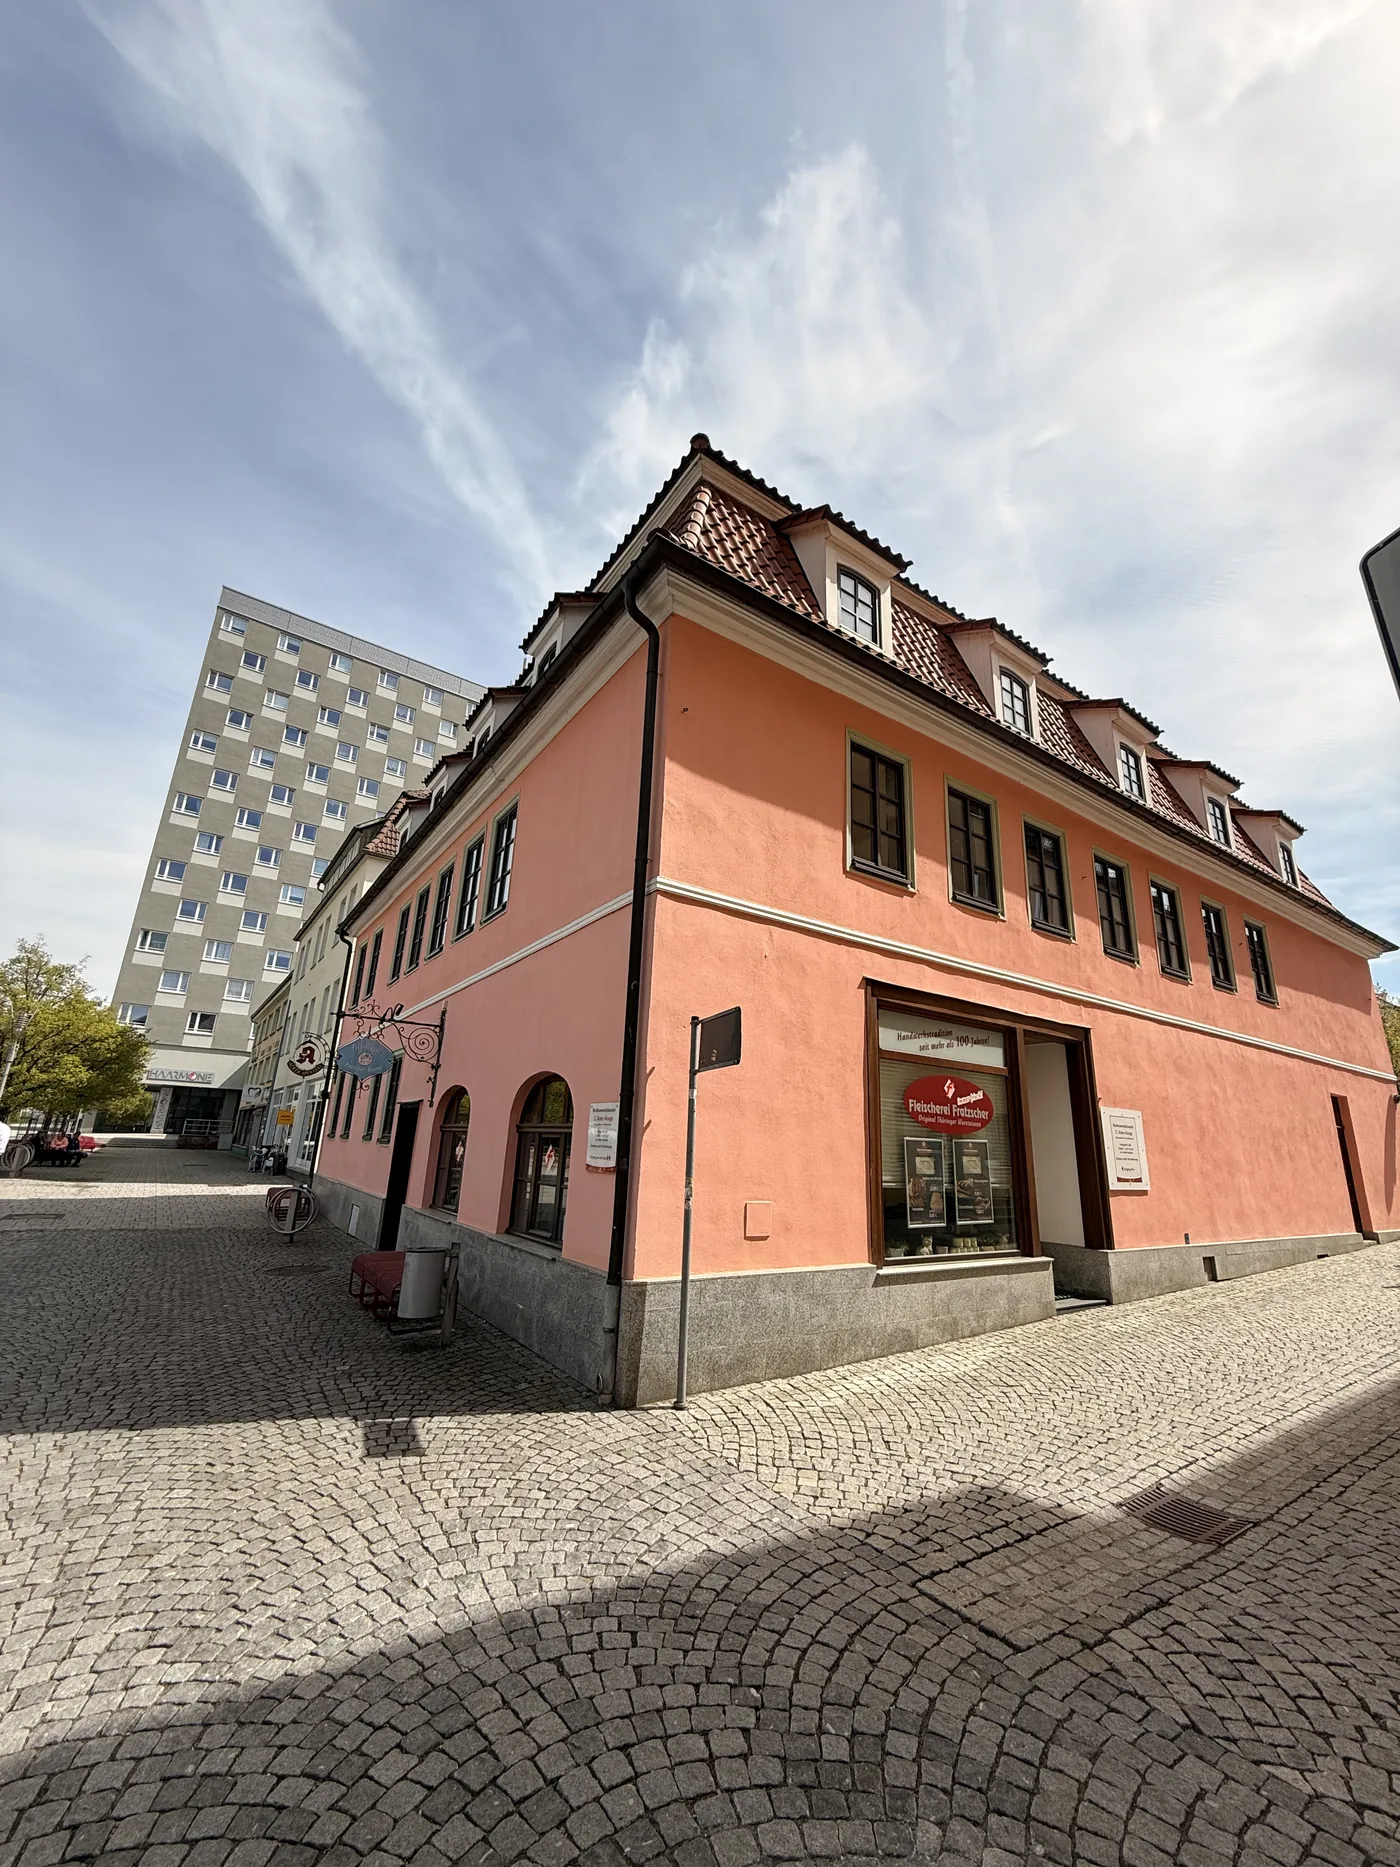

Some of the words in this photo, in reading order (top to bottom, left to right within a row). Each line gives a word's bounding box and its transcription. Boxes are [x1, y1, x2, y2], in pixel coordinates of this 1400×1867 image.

[931, 1041, 945, 1050] mehr
[946, 1040, 955, 1048] als
[956, 1035, 970, 1047] 100
[908, 1098, 951, 1115] Fleischerei
[952, 1104, 989, 1120] Fratzscher
[918, 1114, 937, 1123] Original
